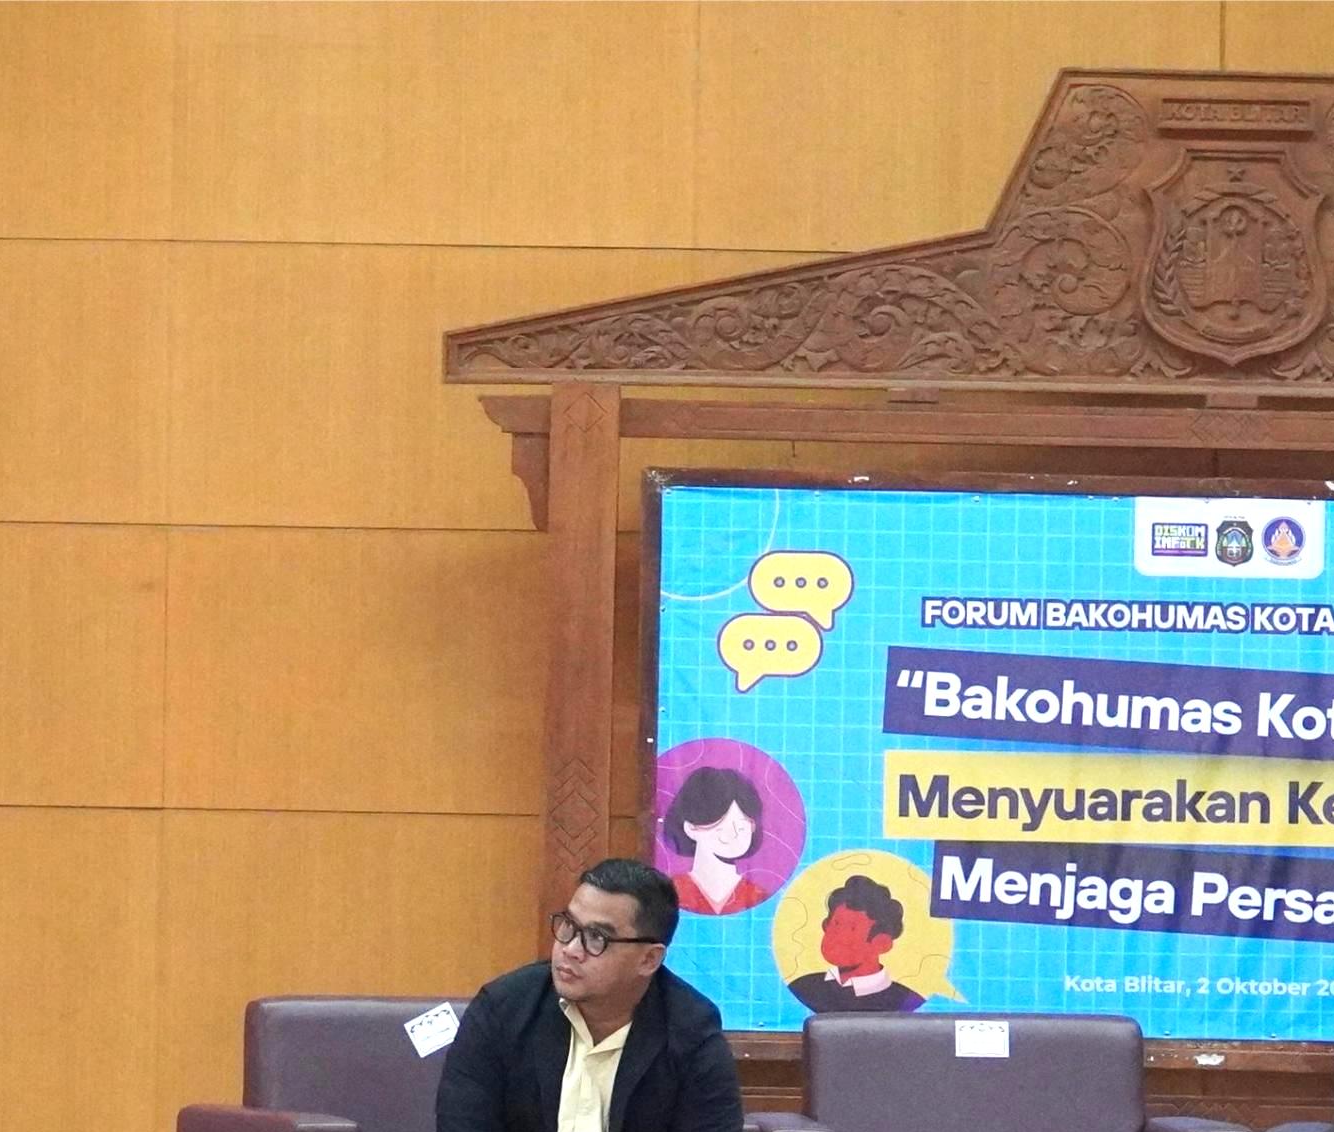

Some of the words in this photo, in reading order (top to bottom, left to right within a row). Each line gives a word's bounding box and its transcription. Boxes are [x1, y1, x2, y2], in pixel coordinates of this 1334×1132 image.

[1154, 525, 1206, 537] DISKOM
[924, 599, 1038, 626] FORUM
[1046, 602, 1247, 631] BAKOHUMAS
[898, 773, 1271, 832] Menyuarakan
[939, 855, 1175, 925] Menjaga
[1063, 975, 1116, 993] Kota
[1124, 976, 1192, 998] Blitar,
[1196, 978, 1210, 995] 2
[1216, 977, 1311, 996] Oktober
